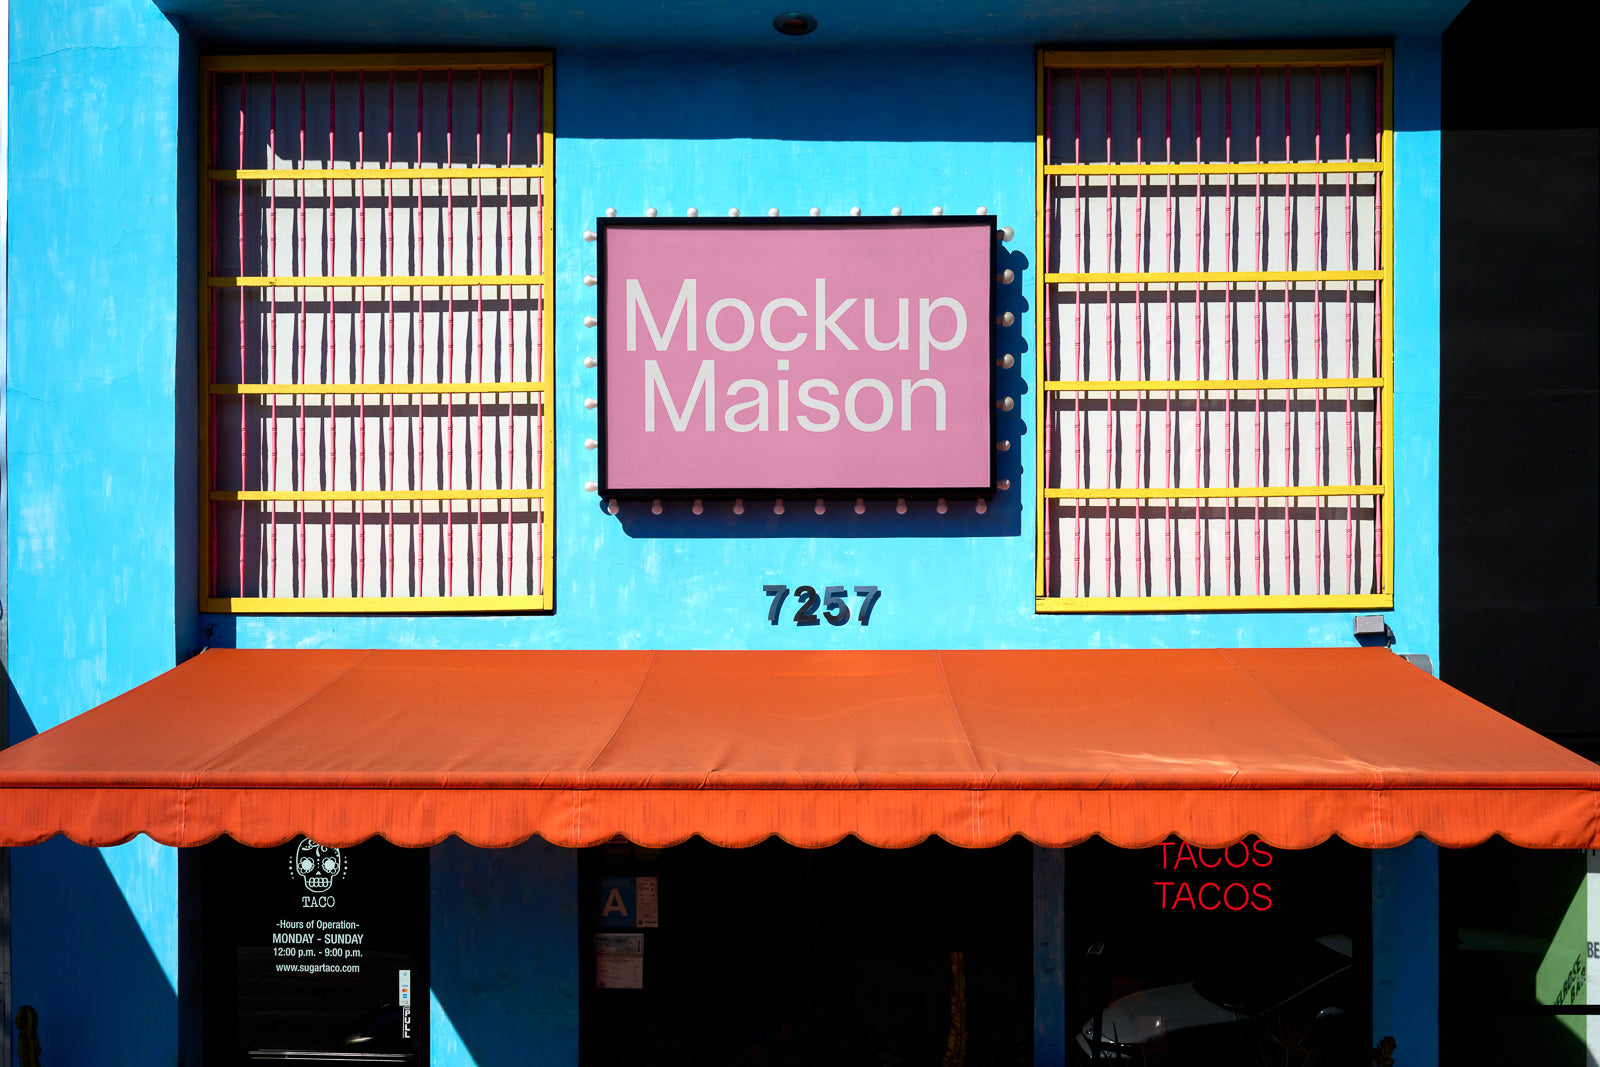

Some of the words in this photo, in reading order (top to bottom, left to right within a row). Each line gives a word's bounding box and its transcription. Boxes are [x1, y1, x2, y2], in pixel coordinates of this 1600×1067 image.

[626, 277, 968, 371] Mockup
[644, 359, 947, 433] Maison
[763, 585, 880, 625] 7257
[1158, 840, 1273, 870] TACOS
[301, 895, 336, 908] TACO
[601, 887, 629, 917] A
[1153, 881, 1273, 911] TACOS
[272, 933, 315, 944] MONDAY
[324, 933, 364, 945] SUNDAY
[275, 919, 304, 930] -Hours
[305, 919, 315, 930] of
[316, 919, 360, 931] Operation-
[272, 947, 296, 957] 12:00
[297, 949, 316, 959] p.m.
[324, 947, 343, 957] 9:00
[344, 949, 363, 959] p.m.
[275, 963, 360, 974] www.sugartaco.com
